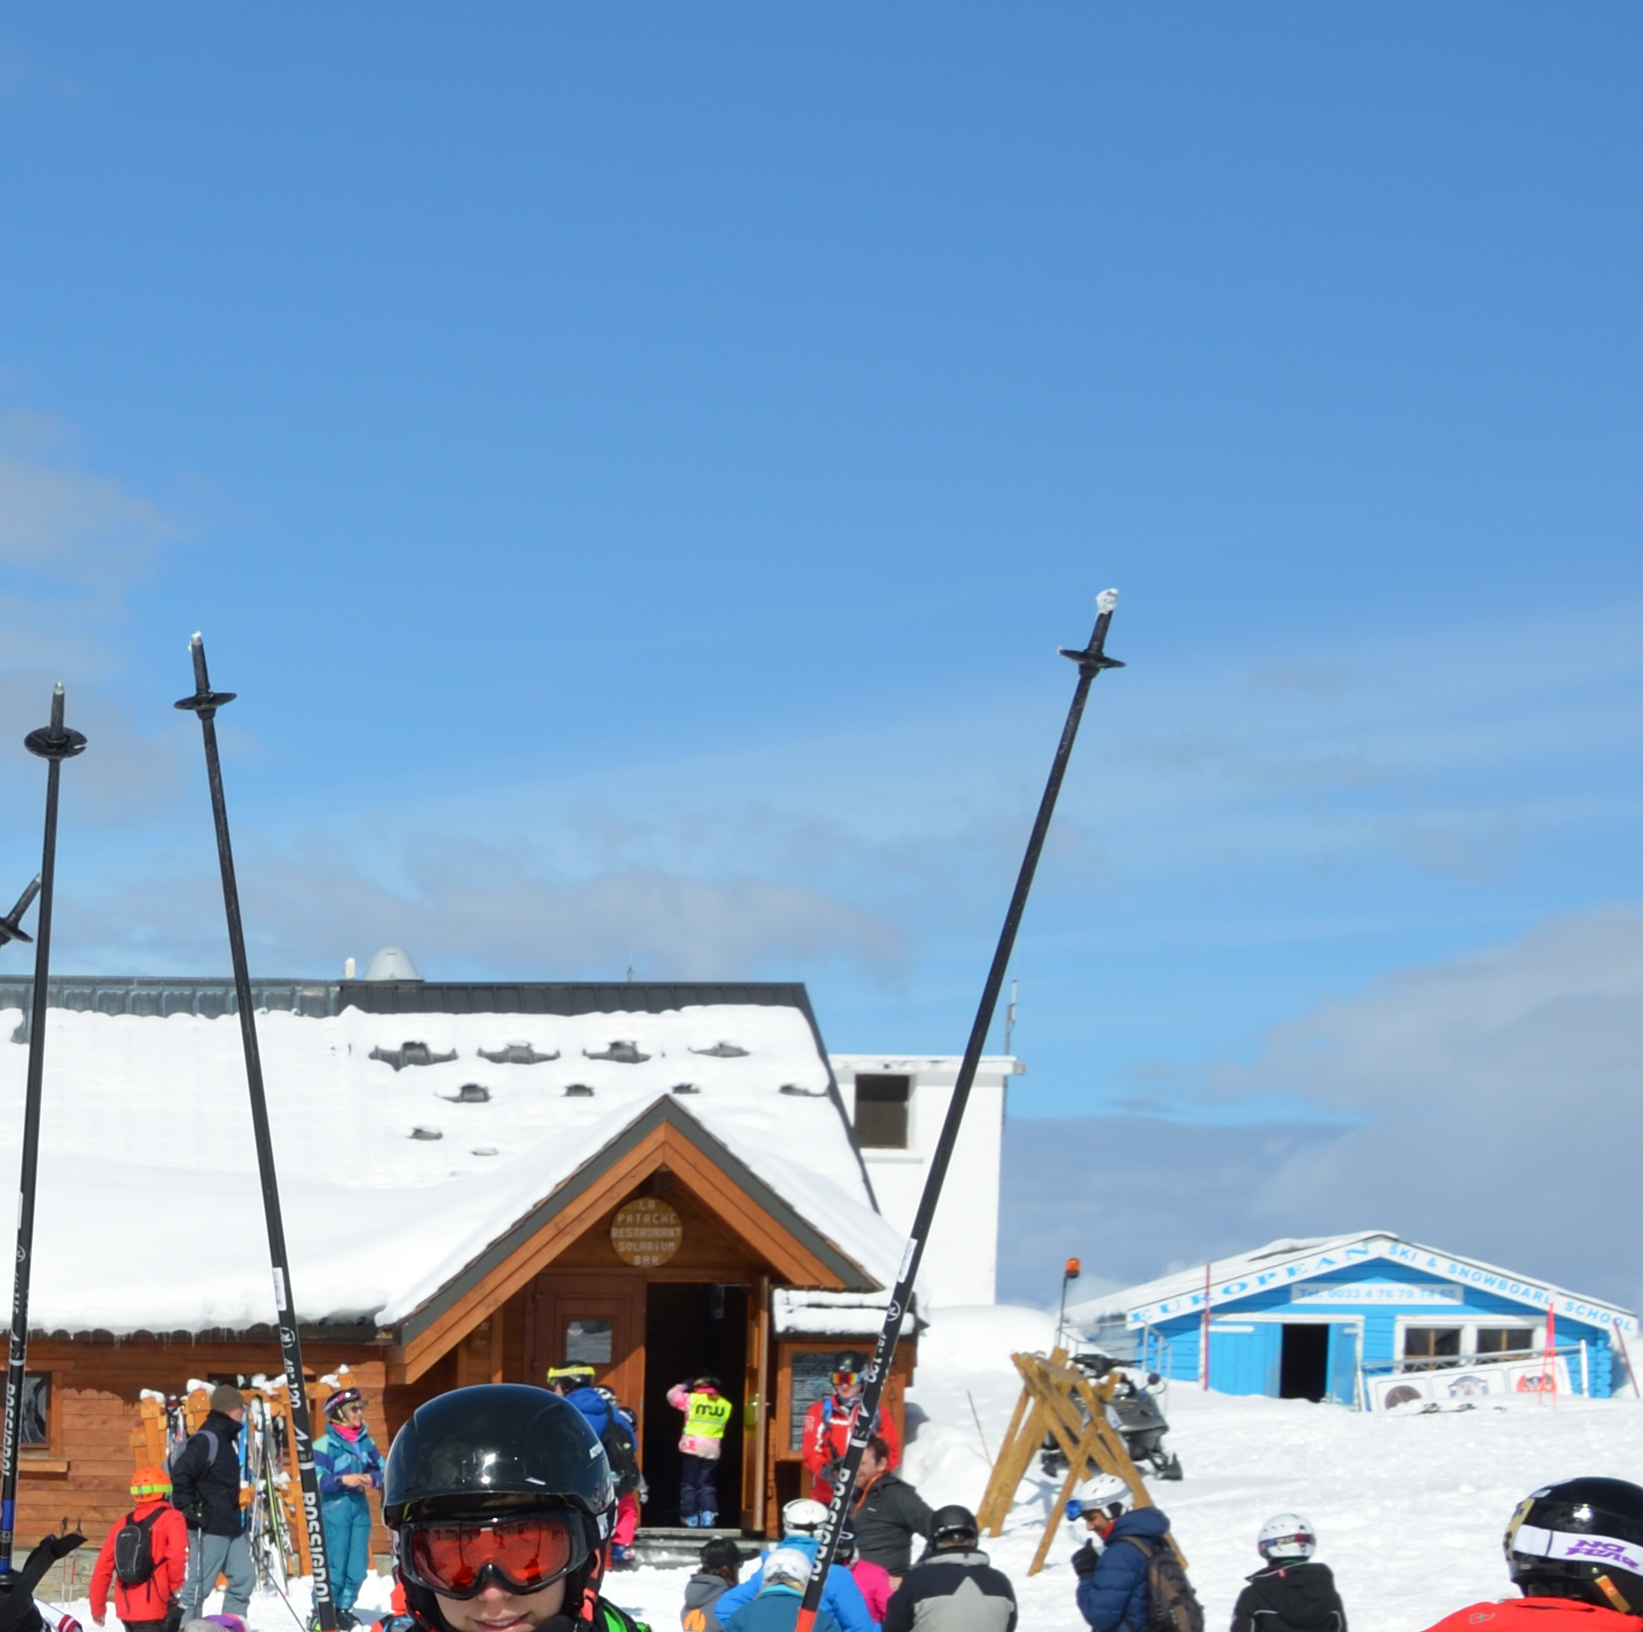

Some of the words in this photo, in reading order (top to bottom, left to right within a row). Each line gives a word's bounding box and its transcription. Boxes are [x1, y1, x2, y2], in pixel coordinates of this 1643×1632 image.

[639, 1200, 656, 1210] LA
[634, 1256, 659, 1266] BAR
[1130, 1243, 1370, 1323] EUROPEAN
[1388, 1243, 1417, 1262] SKI
[1426, 1256, 1437, 1268] &
[1565, 1301, 1632, 1332] SCHOOL
[299, 1491, 332, 1603] ROSSIGNOL
[1576, 1540, 1627, 1552] NO
